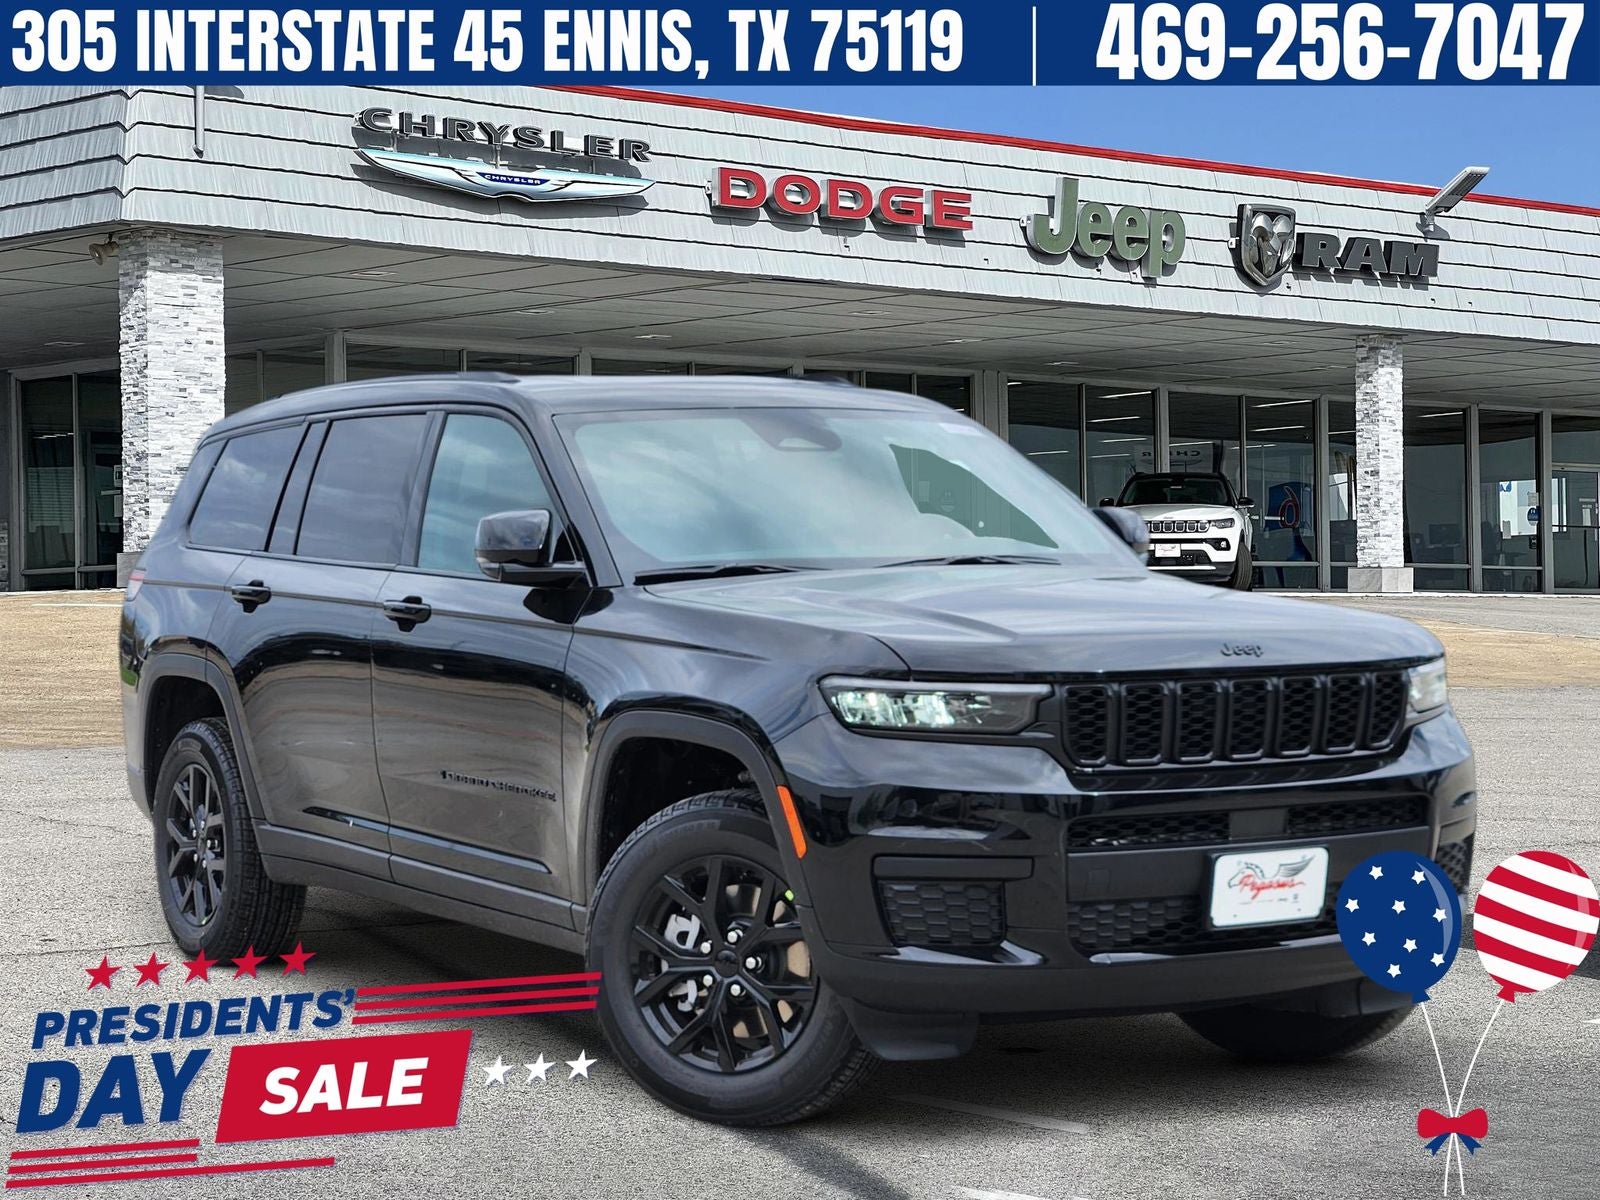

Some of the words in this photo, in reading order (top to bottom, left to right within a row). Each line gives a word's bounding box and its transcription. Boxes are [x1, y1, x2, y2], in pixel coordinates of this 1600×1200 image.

[359, 106, 651, 163] CHRYSLER
[484, 174, 541, 185] CHRYSLER
[712, 167, 973, 231] DODGE
[1027, 176, 1187, 279] Jeep
[1299, 232, 1440, 277] RAM
[1220, 642, 1264, 658] Jeep
